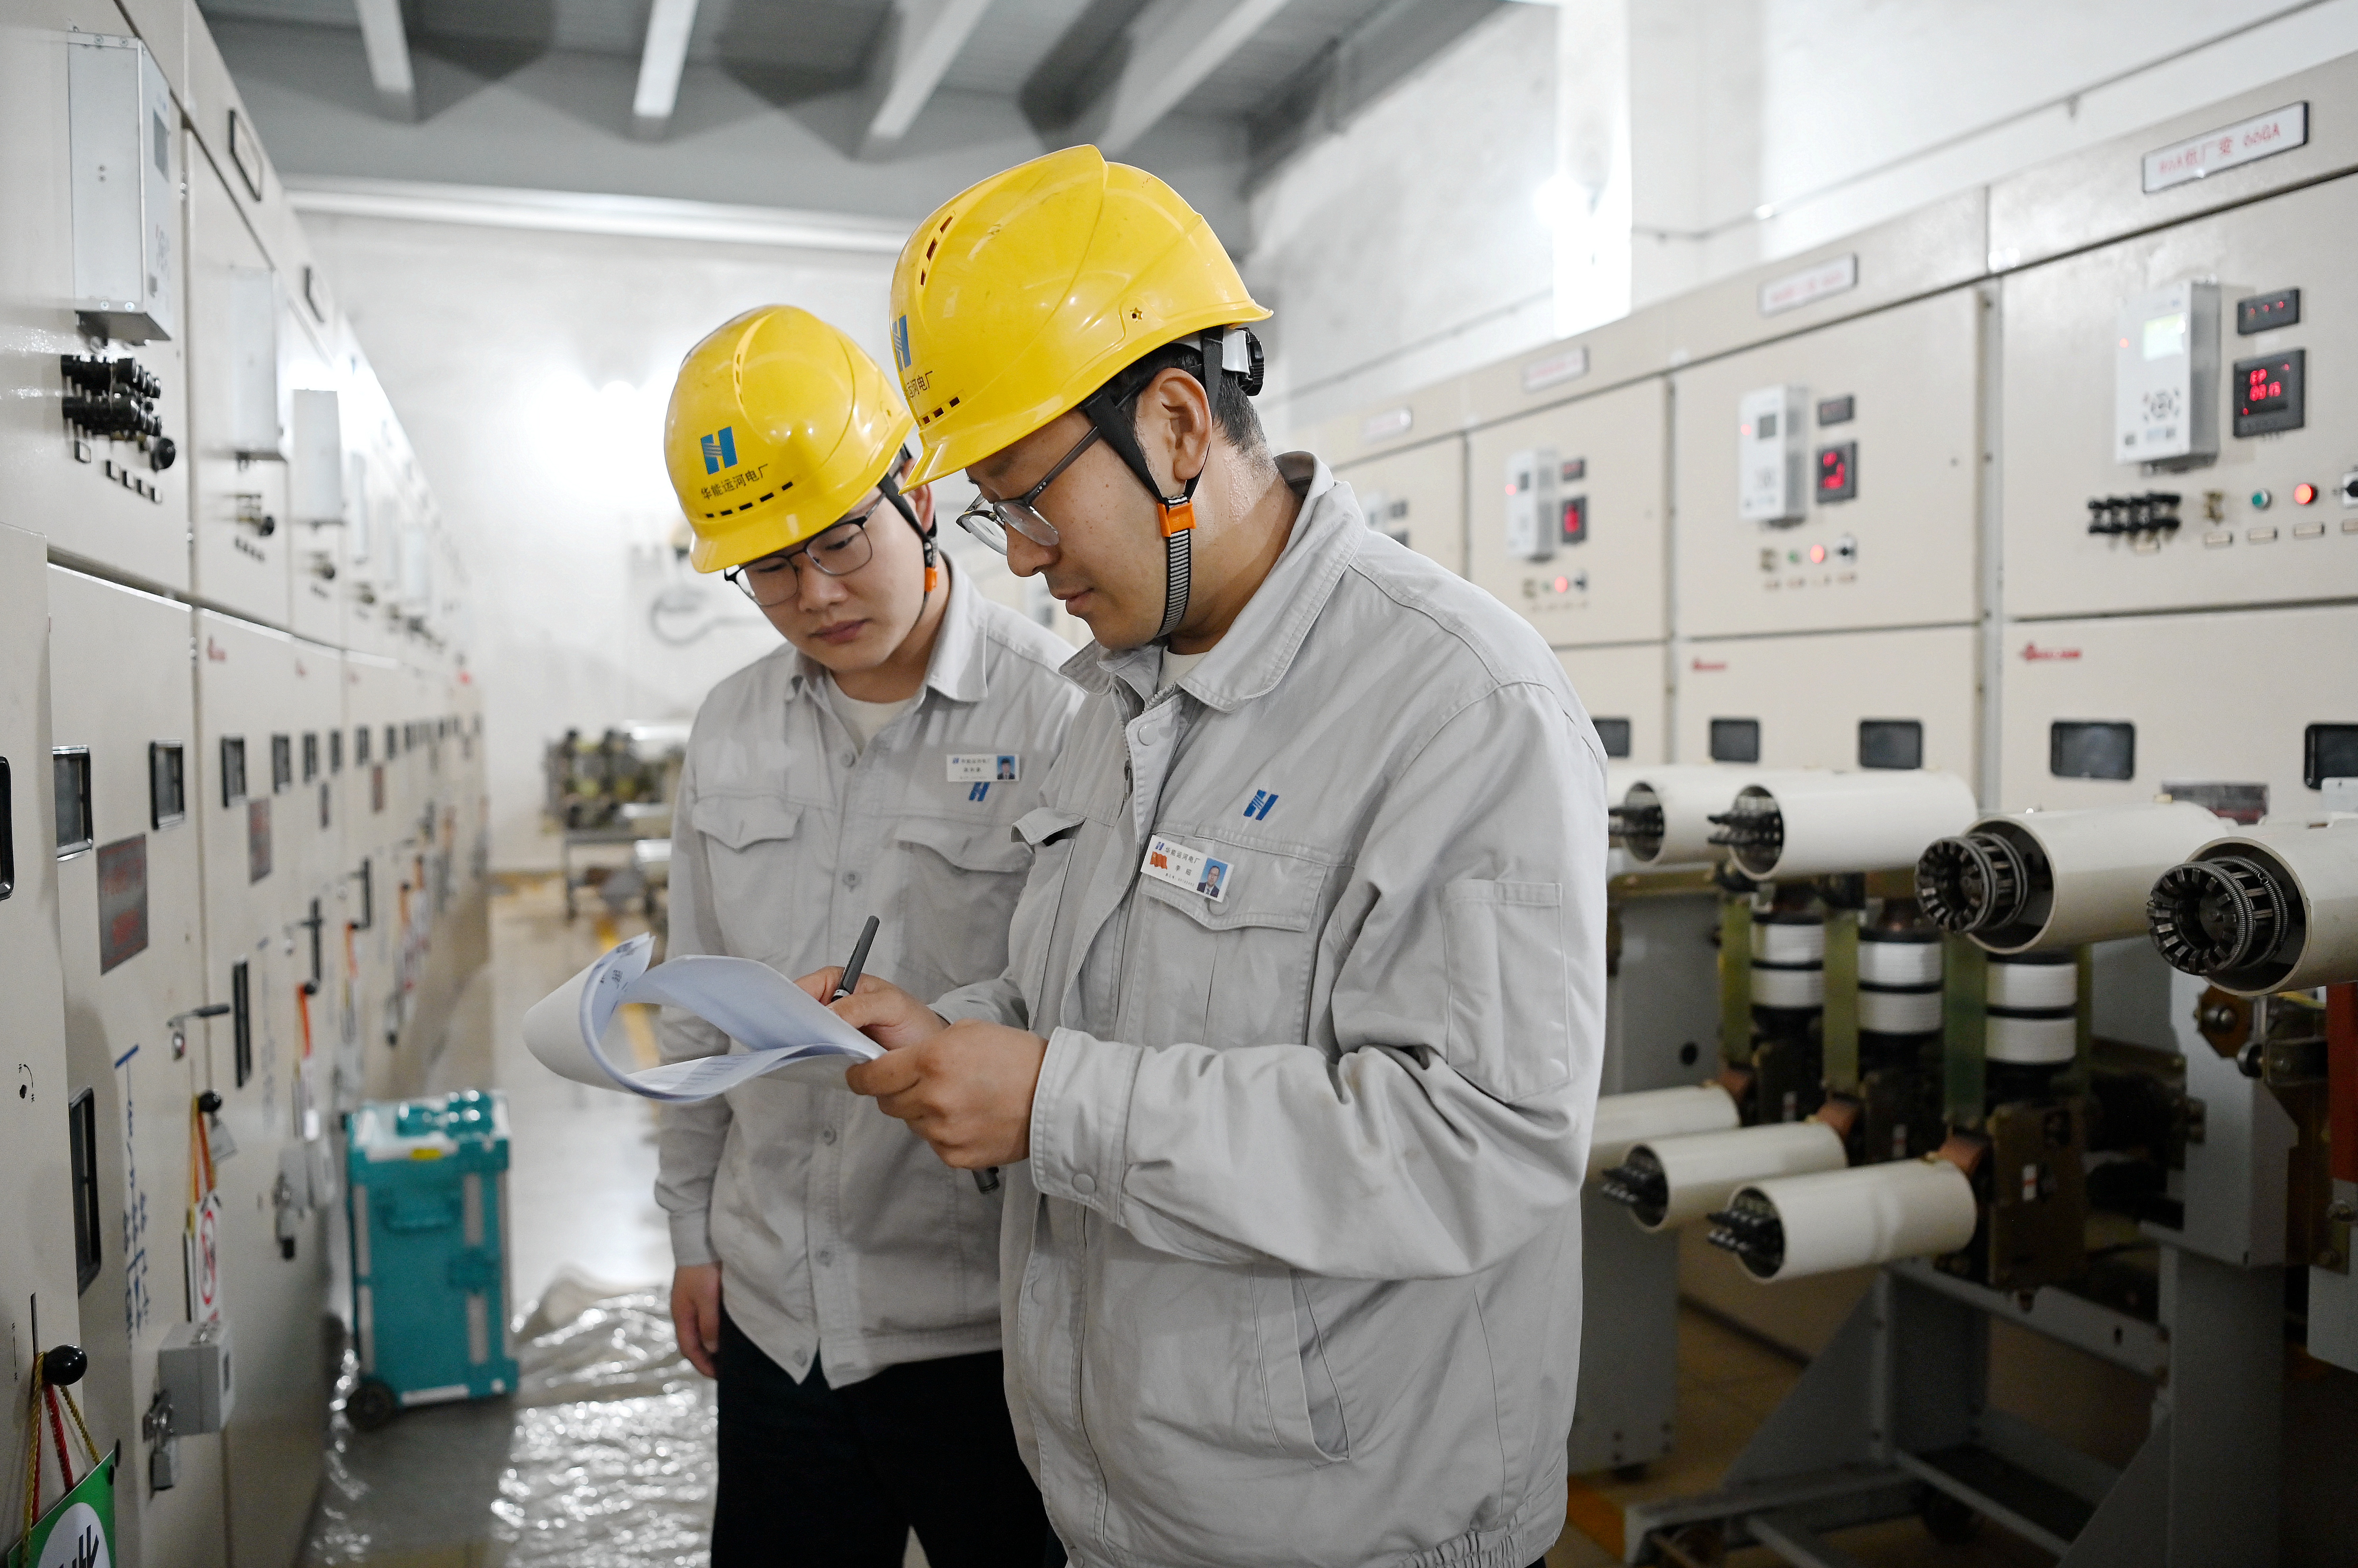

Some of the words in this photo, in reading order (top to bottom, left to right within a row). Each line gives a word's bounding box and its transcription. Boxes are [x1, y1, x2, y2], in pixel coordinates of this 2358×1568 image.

[701, 463, 768, 500] 华能运河电厂
[1165, 847, 1201, 864] 华能运河电厂
